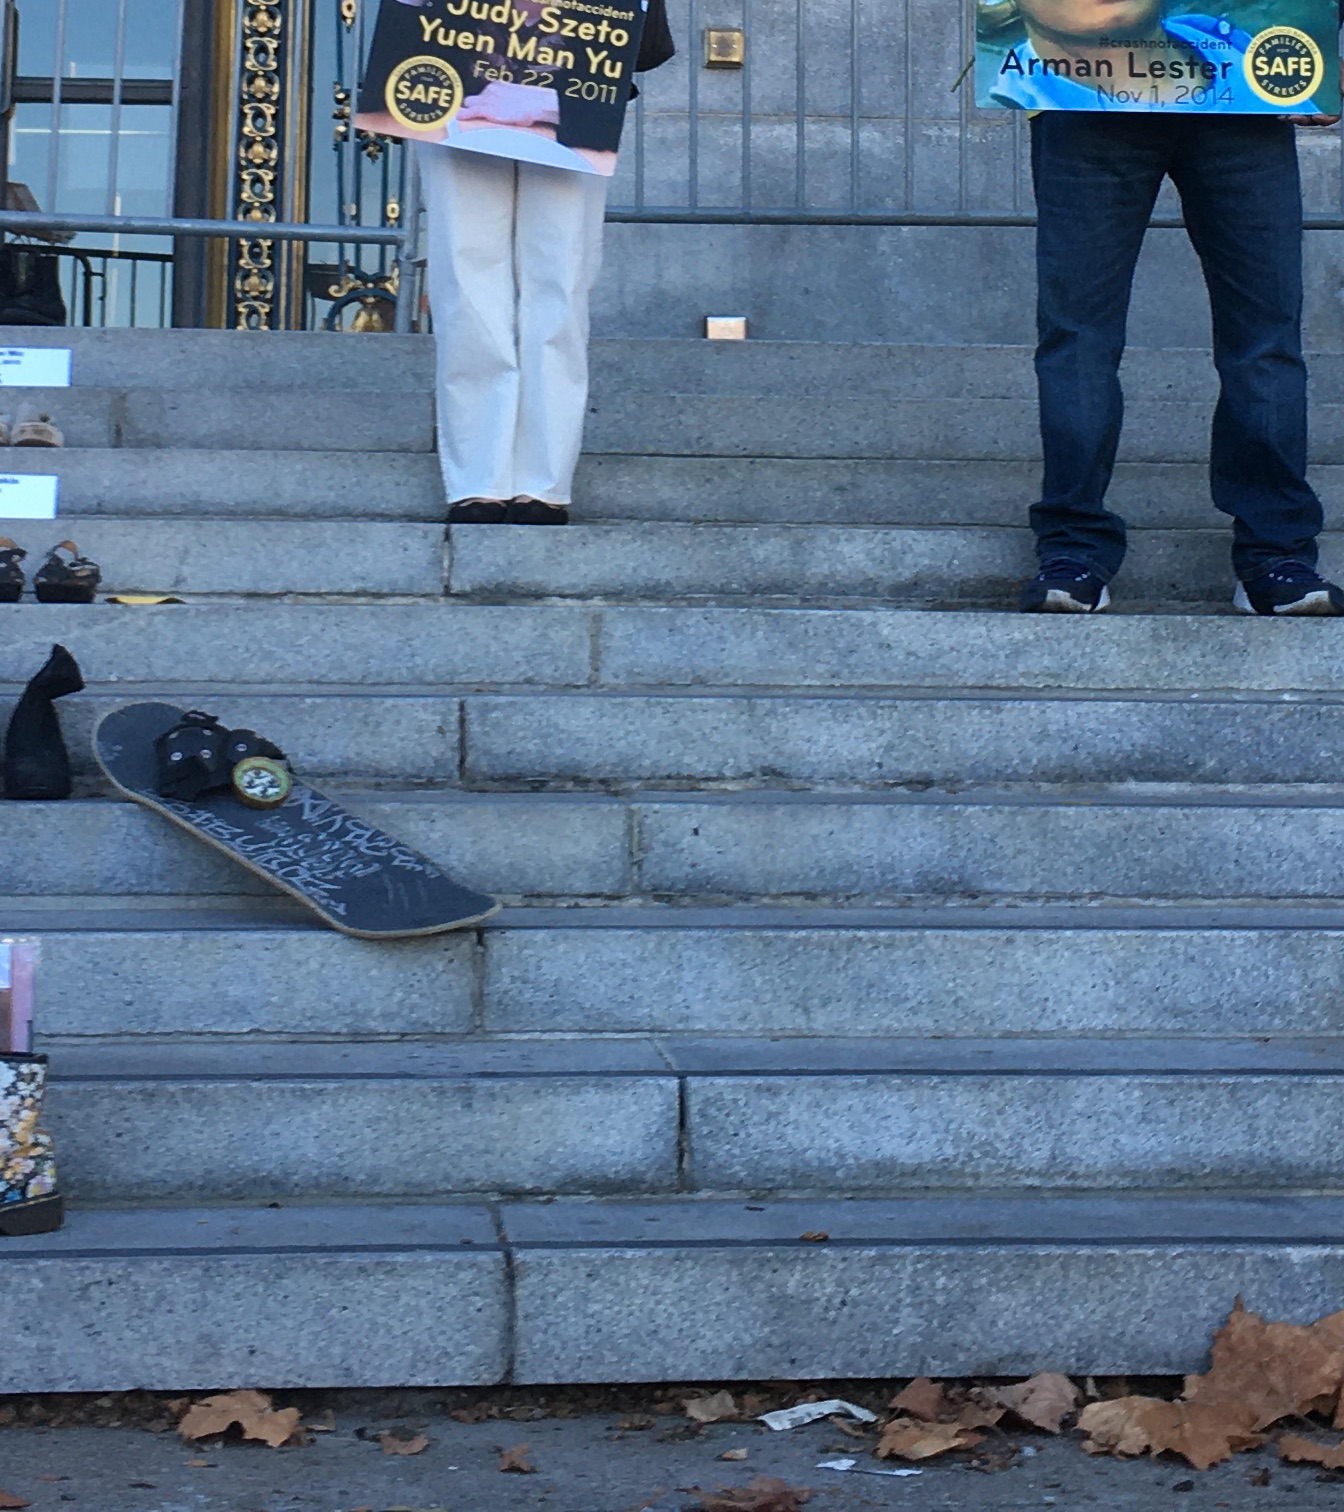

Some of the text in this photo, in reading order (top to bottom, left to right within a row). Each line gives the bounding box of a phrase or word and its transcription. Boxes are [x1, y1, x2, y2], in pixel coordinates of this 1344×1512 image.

[538, 6, 630, 47] Szeto
[418, 14, 624, 79] Yuen Man Yu
[1098, 35, 1234, 50] #crashnotaccident
[1258, 36, 1308, 55] FAMILIES
[999, 48, 1233, 80] Arman Lester
[1255, 56, 1312, 77] SAFE
[396, 80, 453, 108] SAFE
[472, 59, 514, 84] Feb
[564, 77, 618, 105] 2011
[1096, 83, 1144, 104] Nov
[1174, 84, 1235, 105] 2014
[1260, 79, 1308, 96] STREETS
